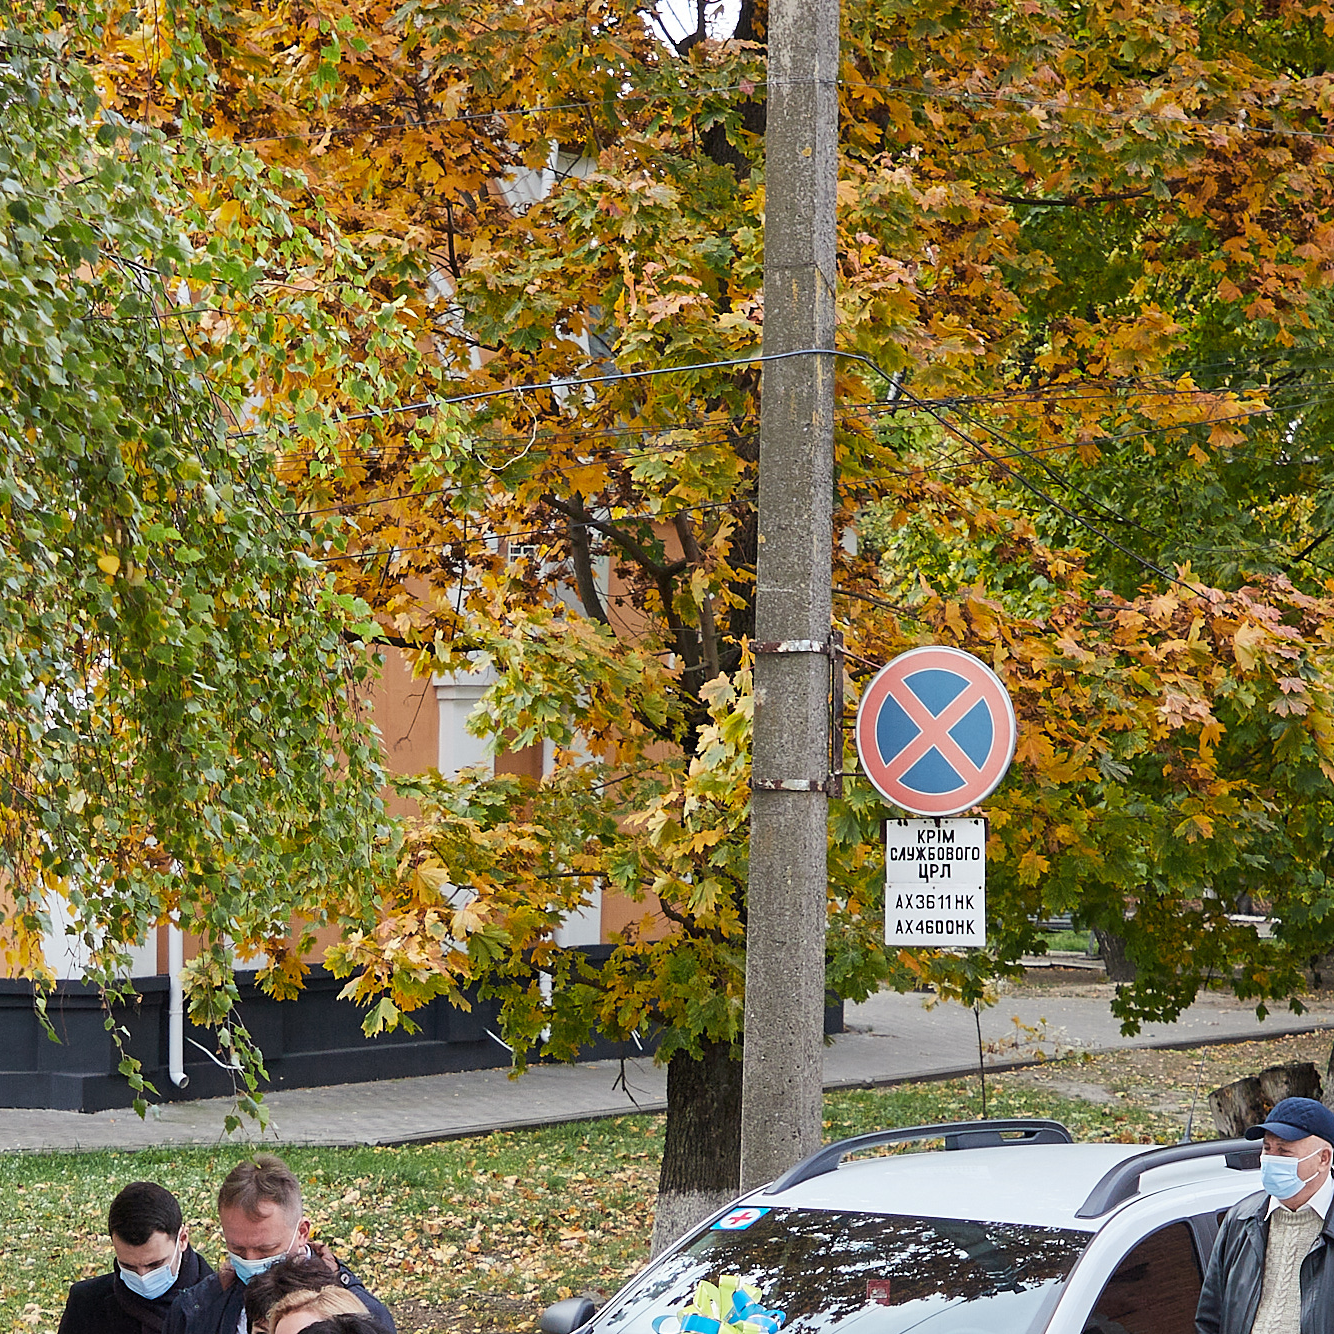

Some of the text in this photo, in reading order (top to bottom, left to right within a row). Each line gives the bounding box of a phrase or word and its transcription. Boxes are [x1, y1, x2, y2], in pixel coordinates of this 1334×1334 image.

[917, 829, 955, 843] КРІМ
[890, 846, 980, 861] СЛУЖБОВОГО
[918, 864, 951, 883] ЦРЛ
[895, 894, 975, 910] AX3611HK
[895, 919, 976, 935] AX4600HK
